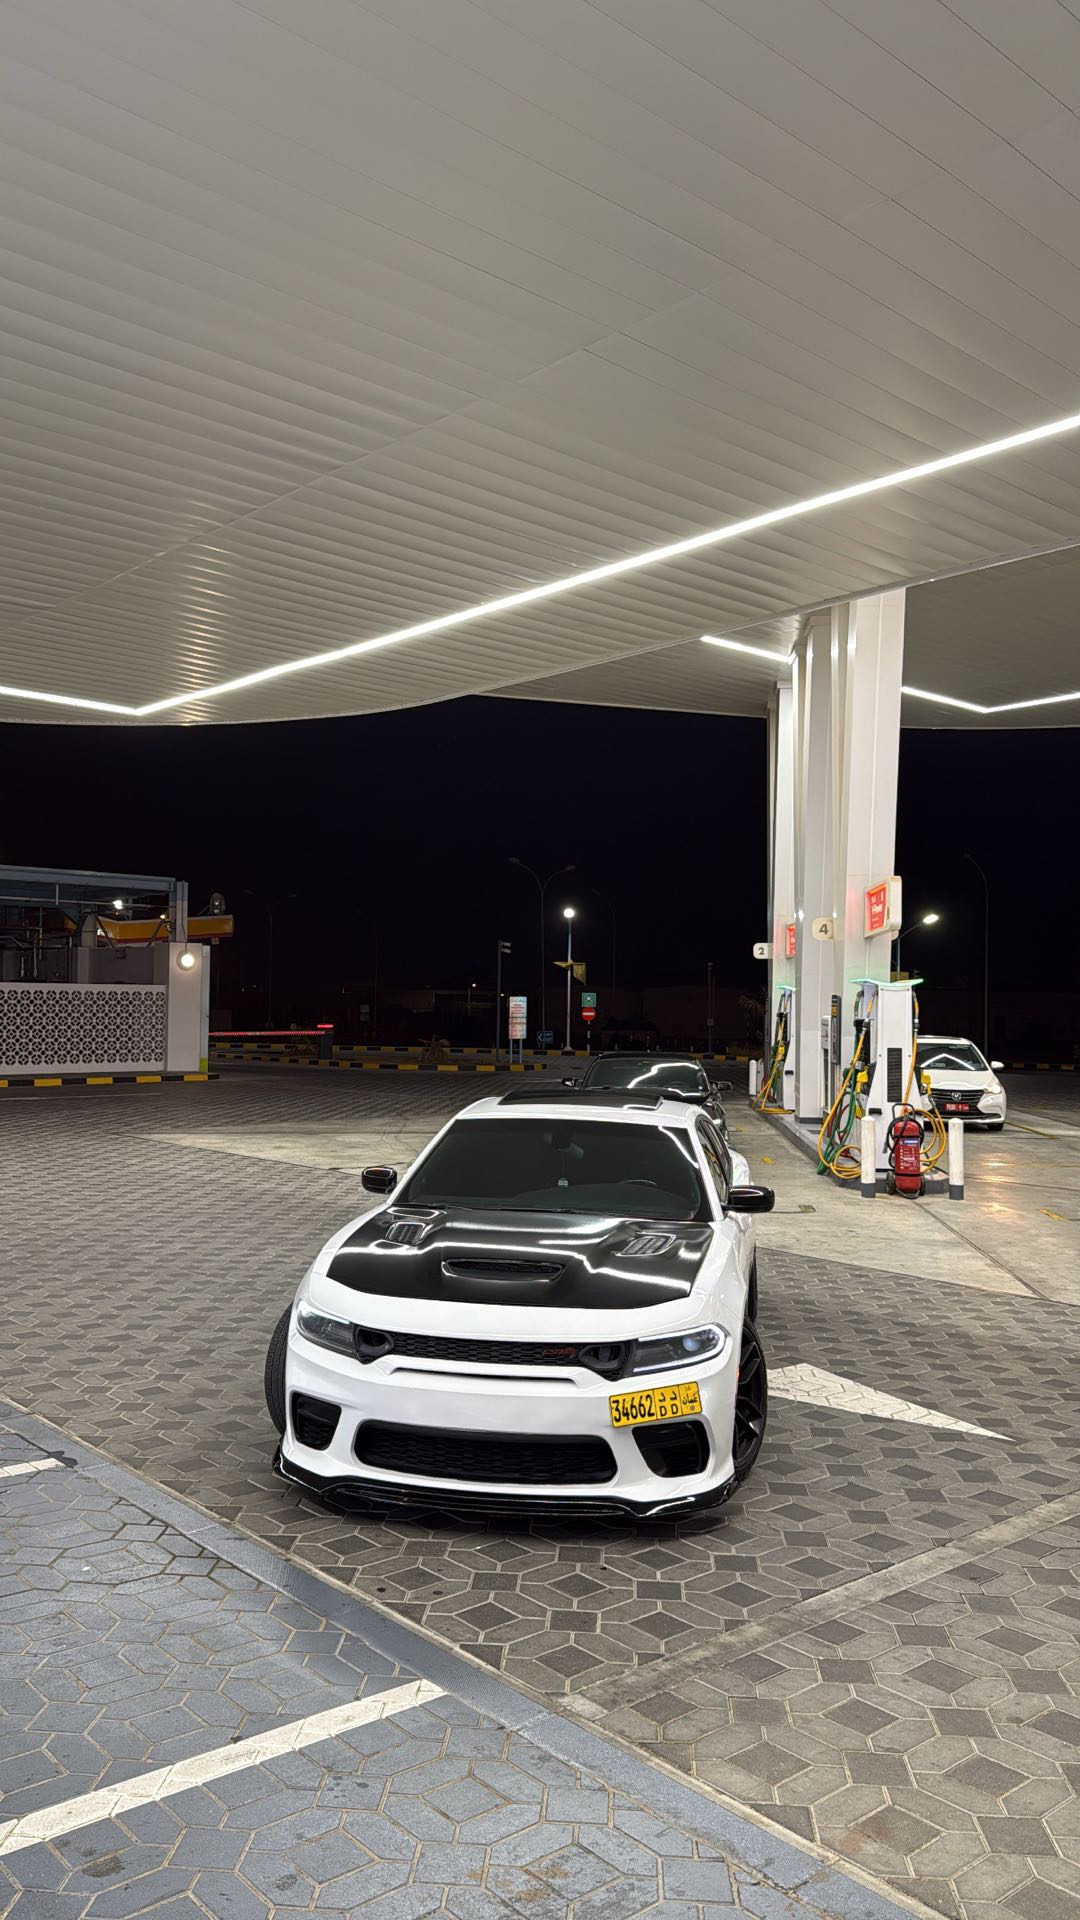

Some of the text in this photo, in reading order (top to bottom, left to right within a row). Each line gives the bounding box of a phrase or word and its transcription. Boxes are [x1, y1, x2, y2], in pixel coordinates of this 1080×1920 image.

[819, 924, 829, 935] 4
[758, 947, 765, 955] 2
[612, 1394, 655, 1422] 34662
